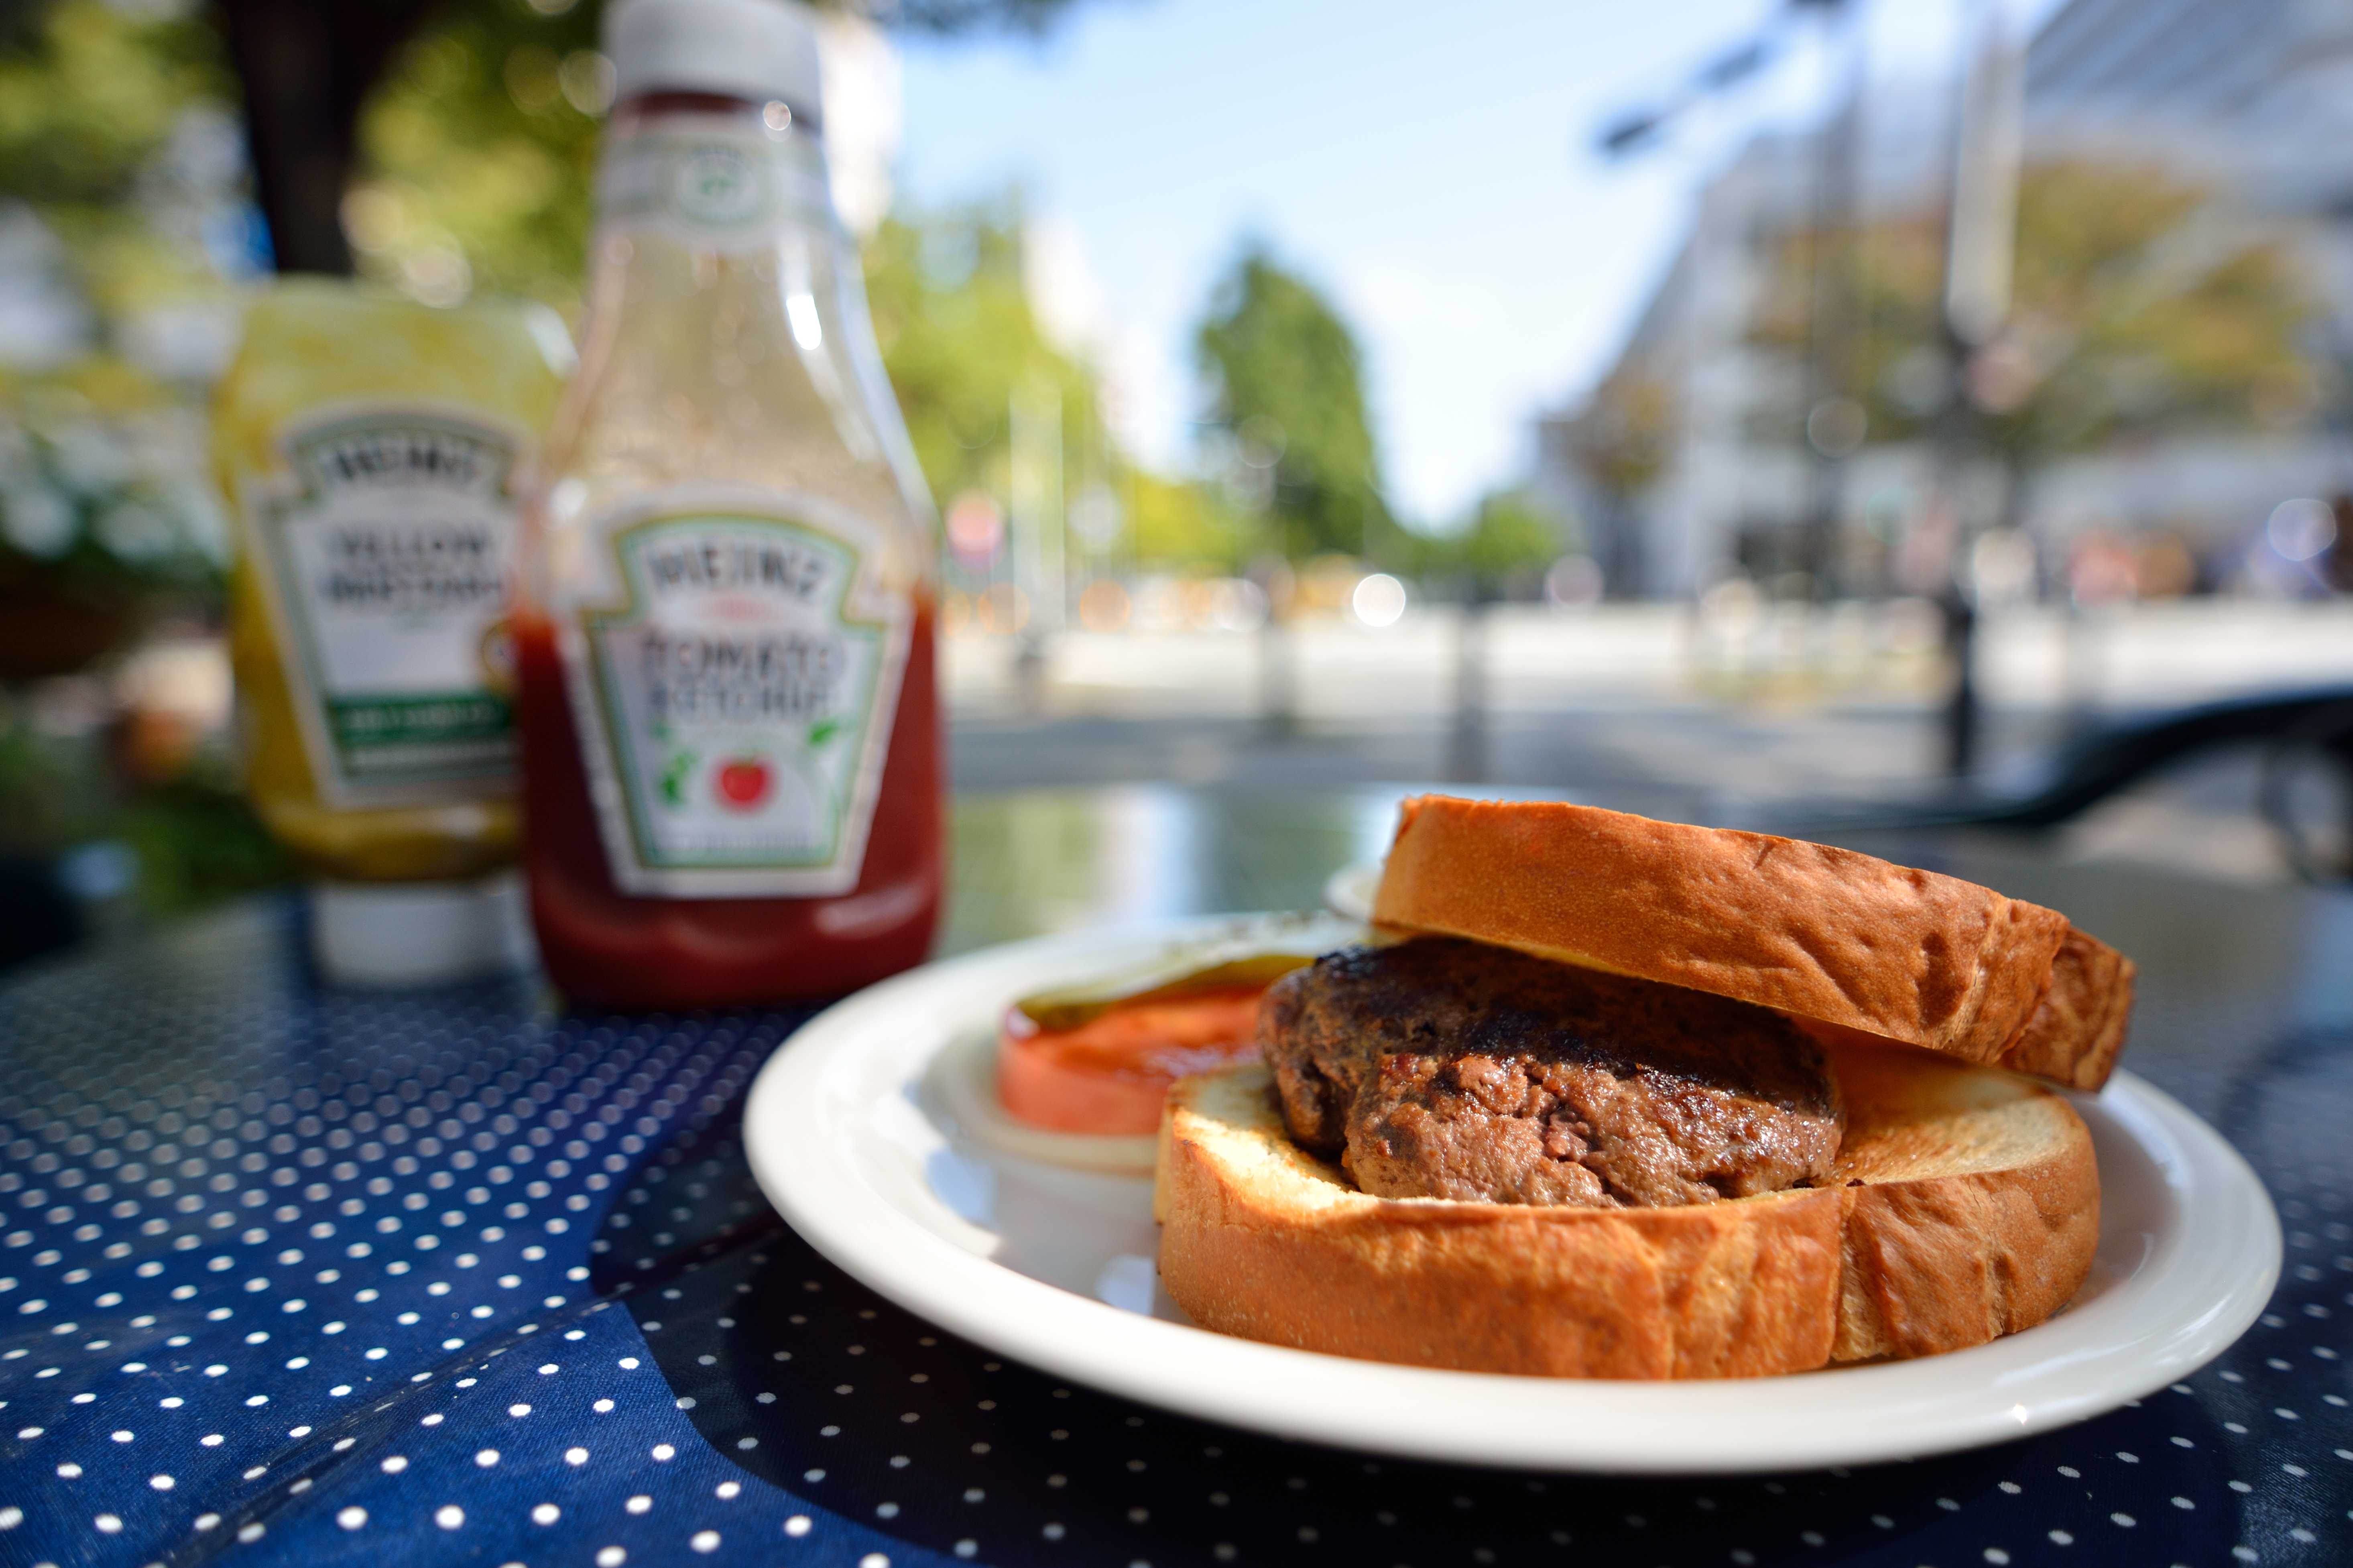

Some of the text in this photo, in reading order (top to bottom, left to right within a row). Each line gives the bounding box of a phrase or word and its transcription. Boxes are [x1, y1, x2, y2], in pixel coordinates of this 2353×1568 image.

[645, 537, 832, 600] HEINZ
[643, 633, 846, 683] TOMATO
[651, 682, 835, 721] KETCHUP
